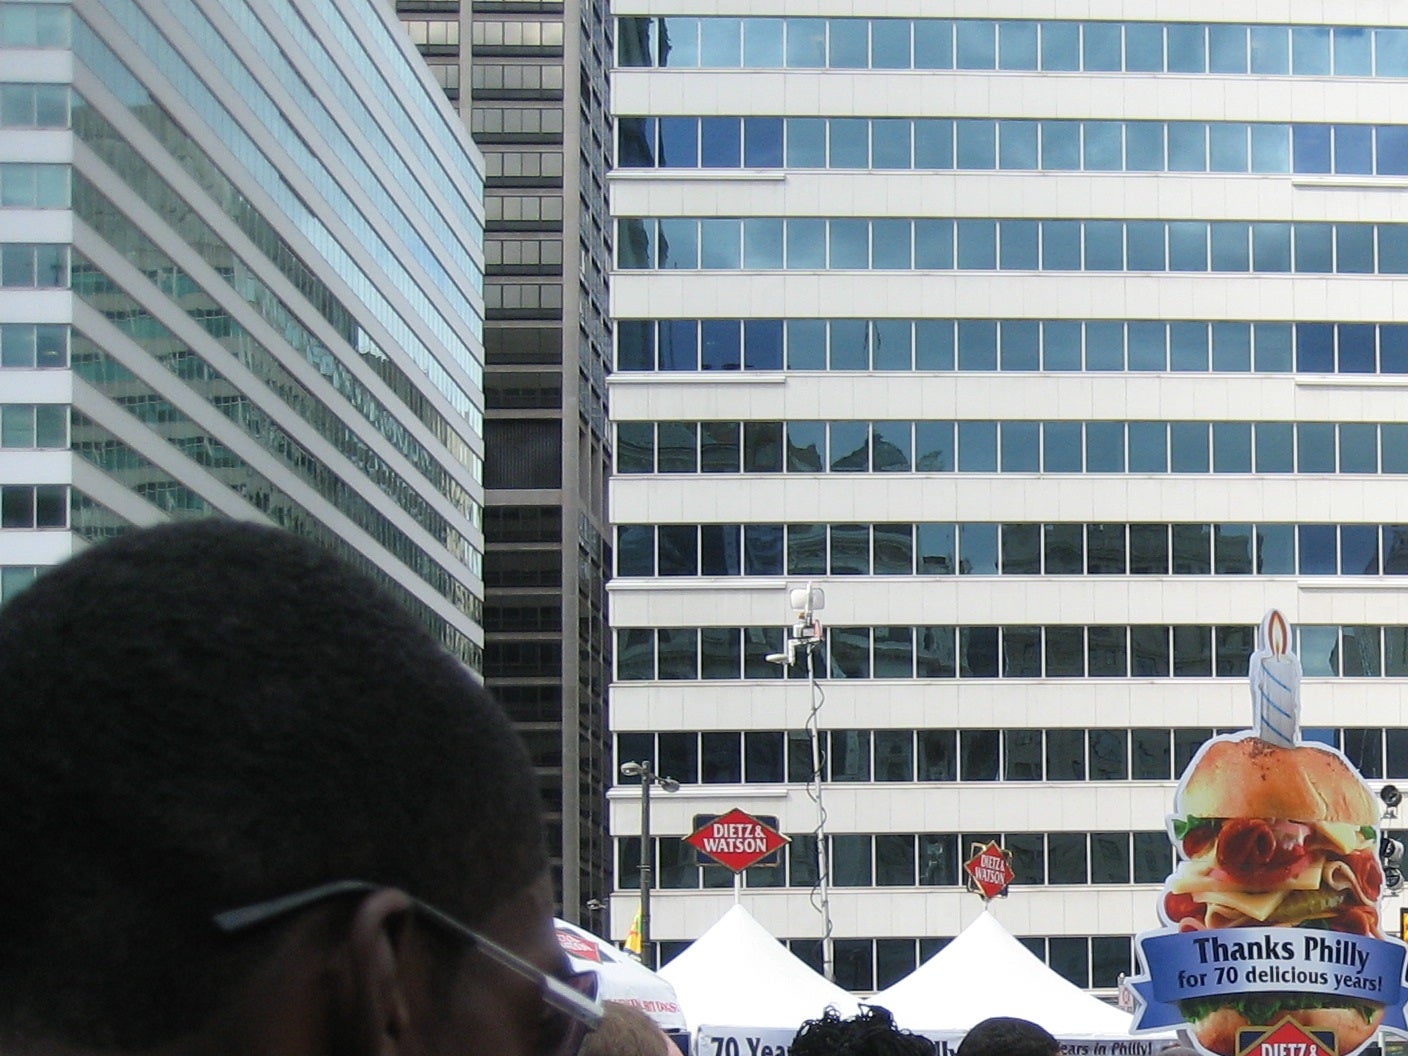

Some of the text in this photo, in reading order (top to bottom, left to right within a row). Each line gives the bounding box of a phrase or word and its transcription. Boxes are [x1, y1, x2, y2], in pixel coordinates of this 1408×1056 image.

[713, 824, 767, 838] DIETZ &
[703, 839, 767, 853] WATSON
[981, 854, 1000, 870] DIETZ
[975, 866, 1005, 885] WATSON
[1193, 935, 1370, 974] Thanks Philly
[1178, 965, 1383, 992] for 70 delicious years!
[1061, 1044, 1089, 1055] ears
[1094, 1042, 1106, 1055] in
